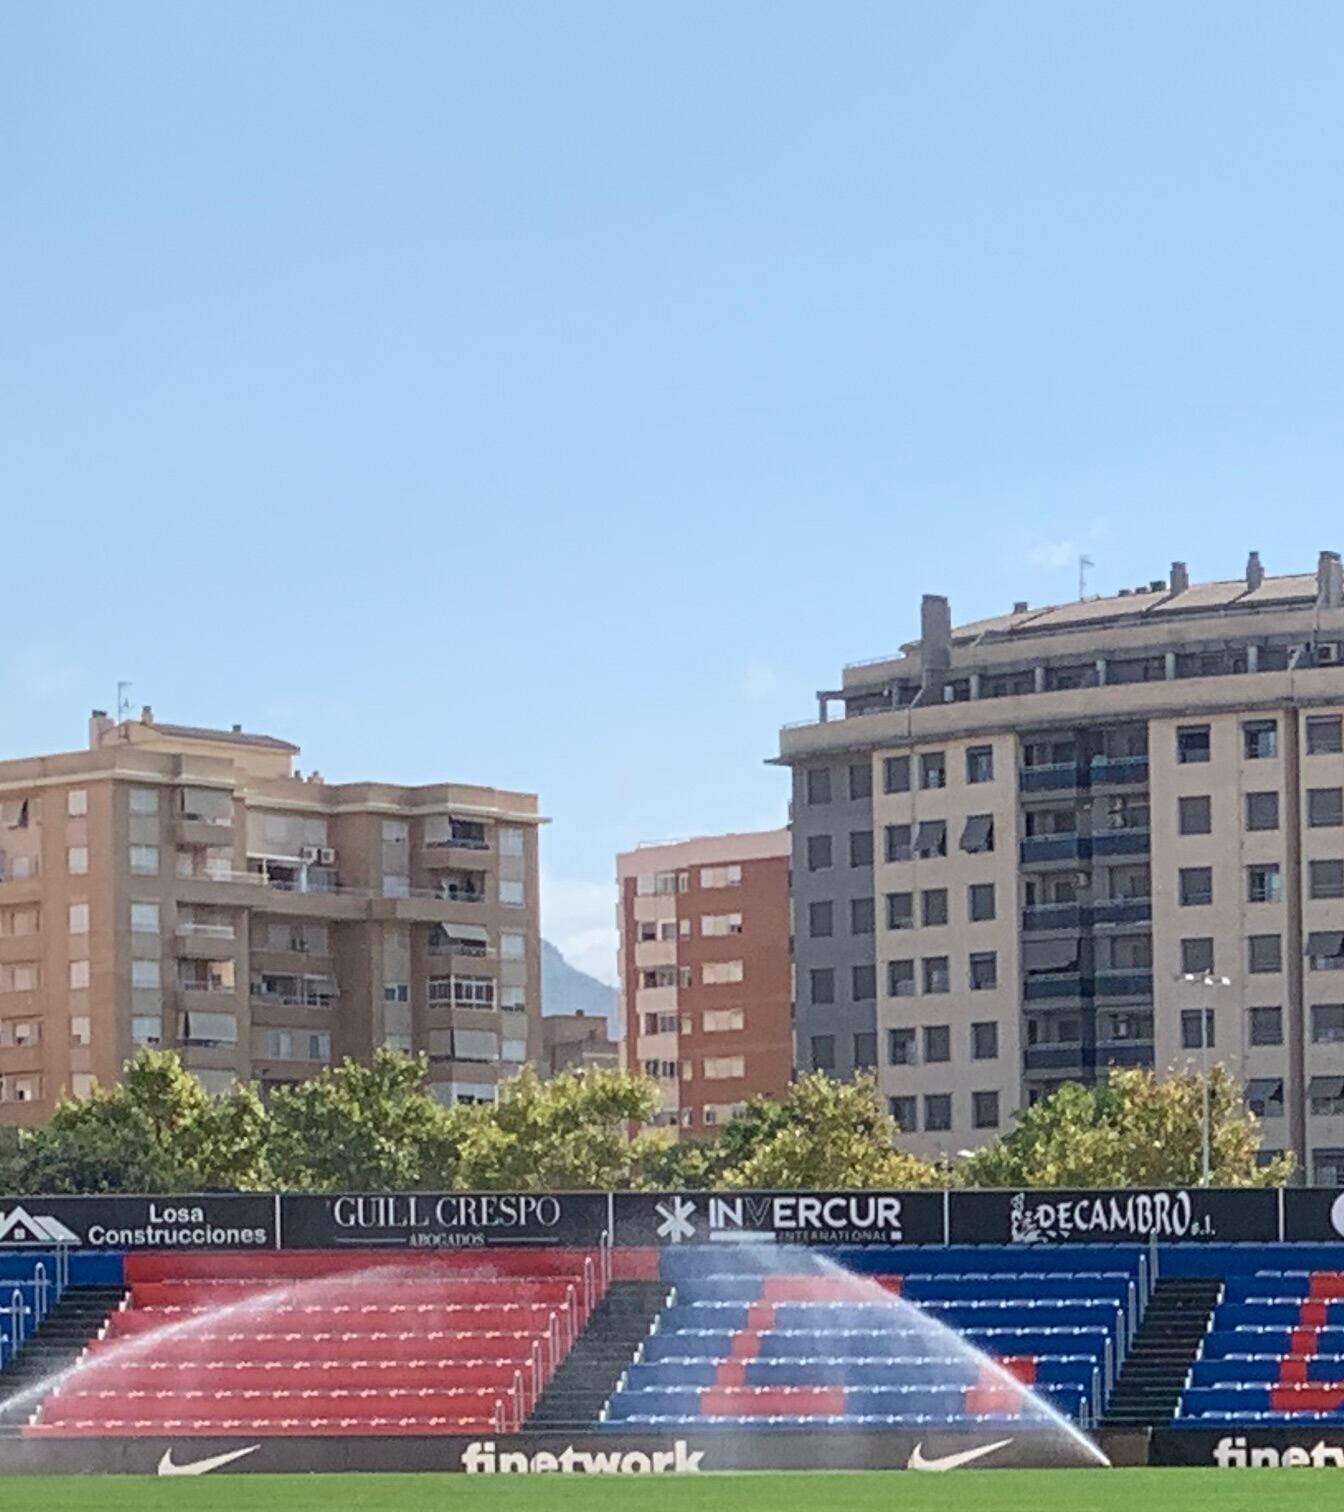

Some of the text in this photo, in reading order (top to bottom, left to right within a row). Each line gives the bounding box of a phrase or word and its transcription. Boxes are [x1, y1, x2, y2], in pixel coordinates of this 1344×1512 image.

[150, 1204, 203, 1223] Losa
[334, 1196, 561, 1228] GUILL CRESPO
[709, 1197, 901, 1229] INVERCUR
[88, 1225, 267, 1245] Construcciones
[408, 1232, 486, 1247] ABOGADOS
